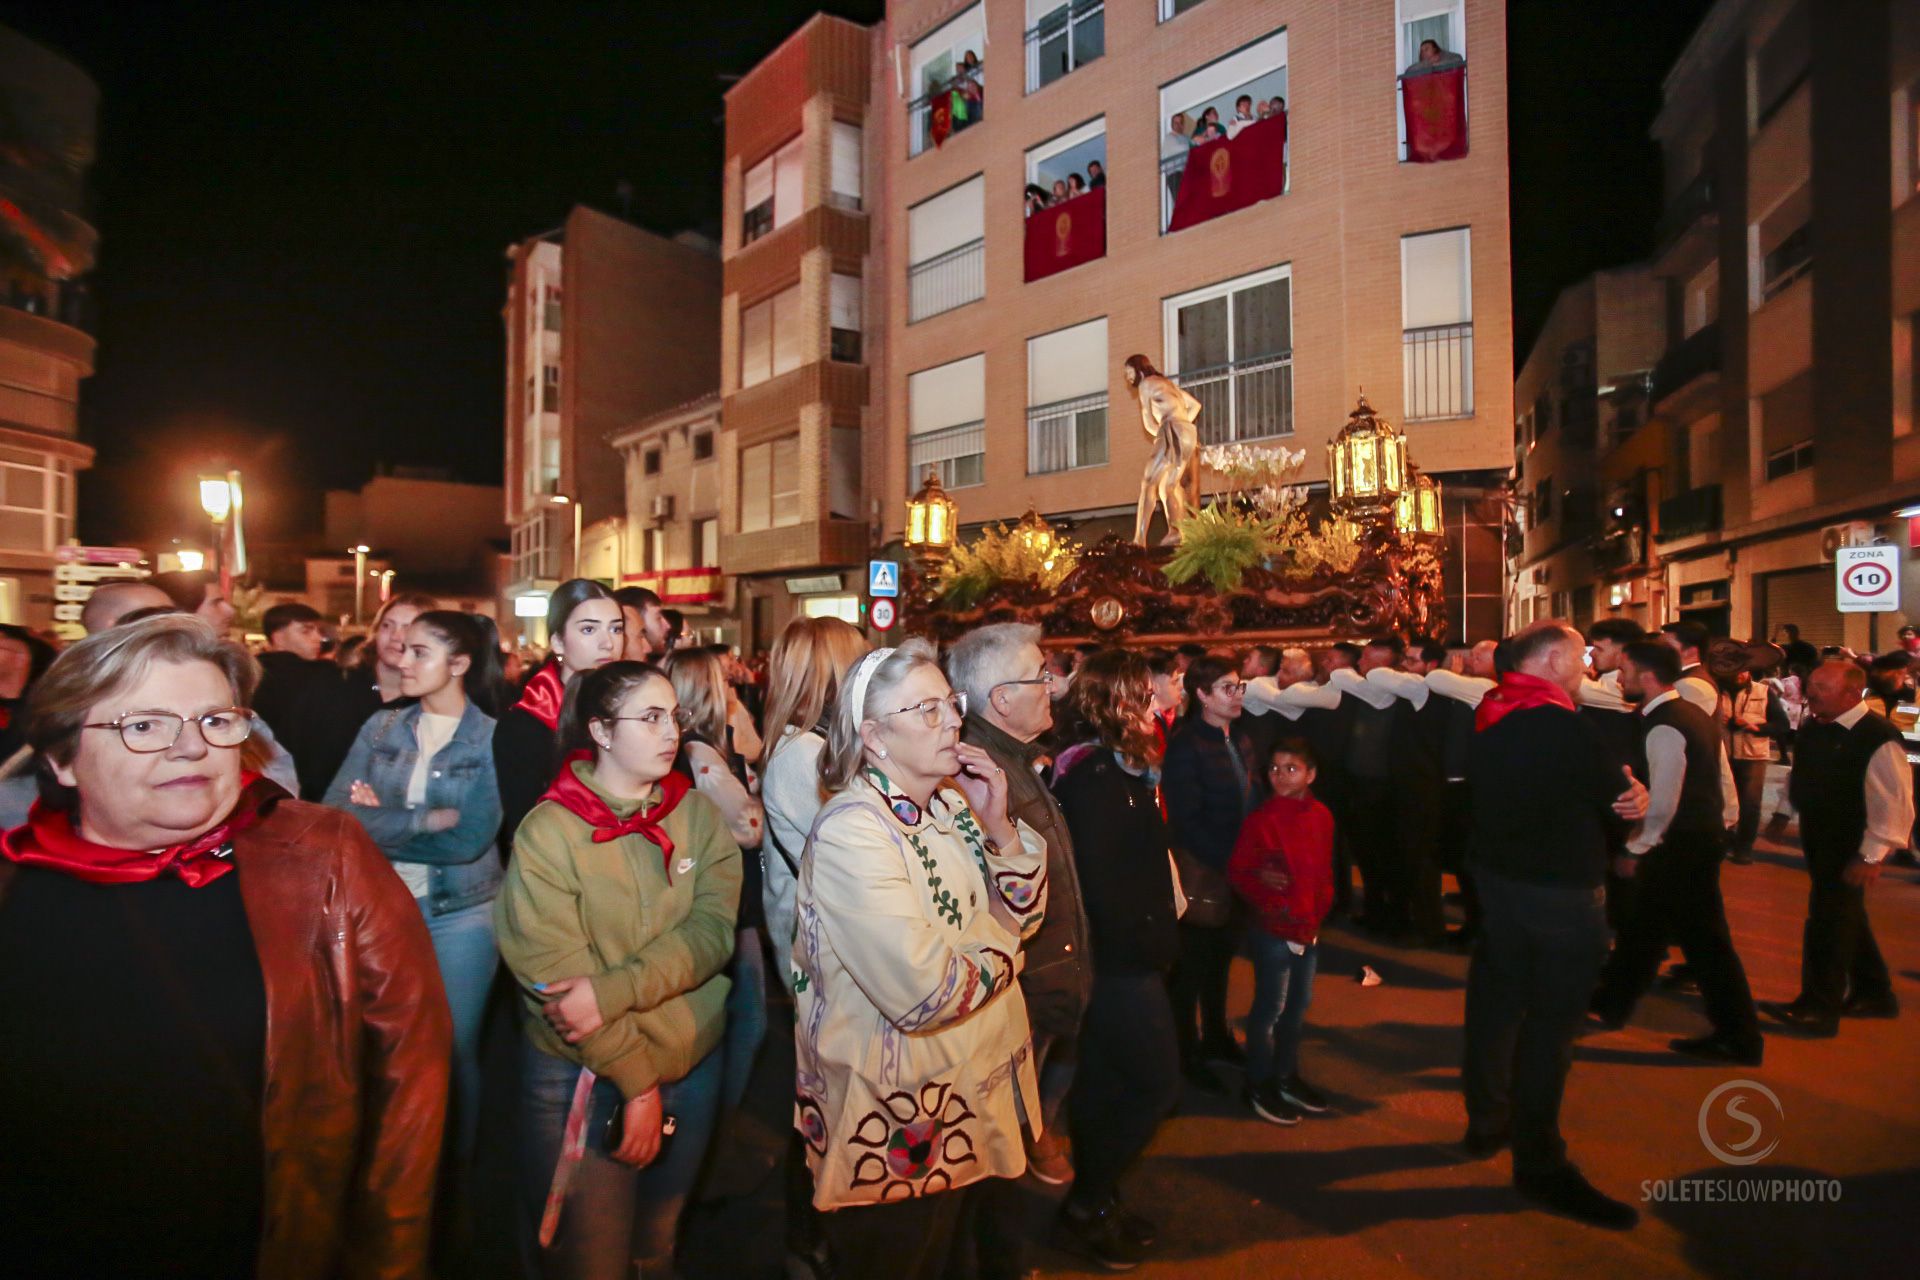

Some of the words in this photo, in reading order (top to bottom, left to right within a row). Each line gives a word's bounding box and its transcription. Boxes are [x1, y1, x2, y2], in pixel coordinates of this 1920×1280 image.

[1849, 551, 1884, 559] ZONA
[1854, 573, 1881, 585] 10
[877, 608, 890, 620] 30
